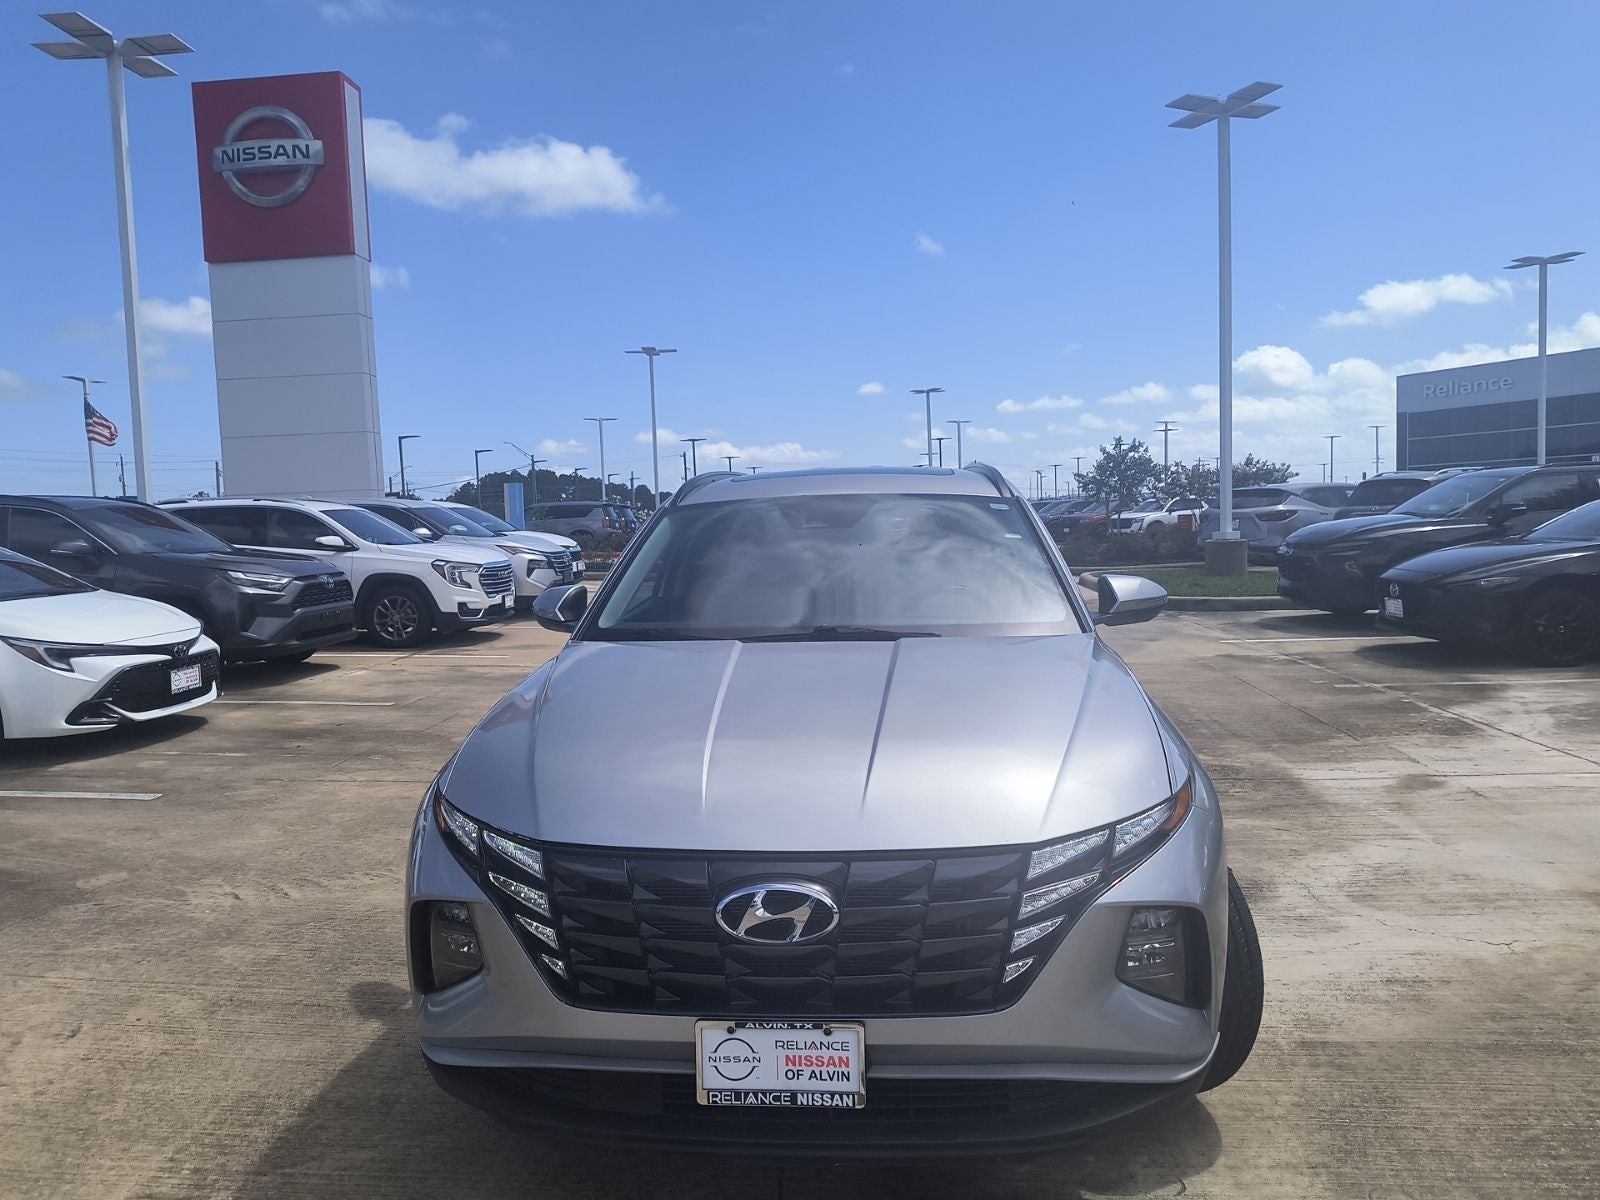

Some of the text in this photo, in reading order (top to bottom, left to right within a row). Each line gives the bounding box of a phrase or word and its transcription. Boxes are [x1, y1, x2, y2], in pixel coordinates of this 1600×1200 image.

[221, 144, 310, 165] NISSAN
[1422, 377, 1513, 399] Reliance
[774, 1040, 850, 1051] RELIANCE
[708, 1055, 761, 1064] NISSAN
[784, 1054, 850, 1068] NISSAN
[784, 1069, 850, 1082] OF ALVIN
[709, 1092, 853, 1107] RELIANCE NISSAN
